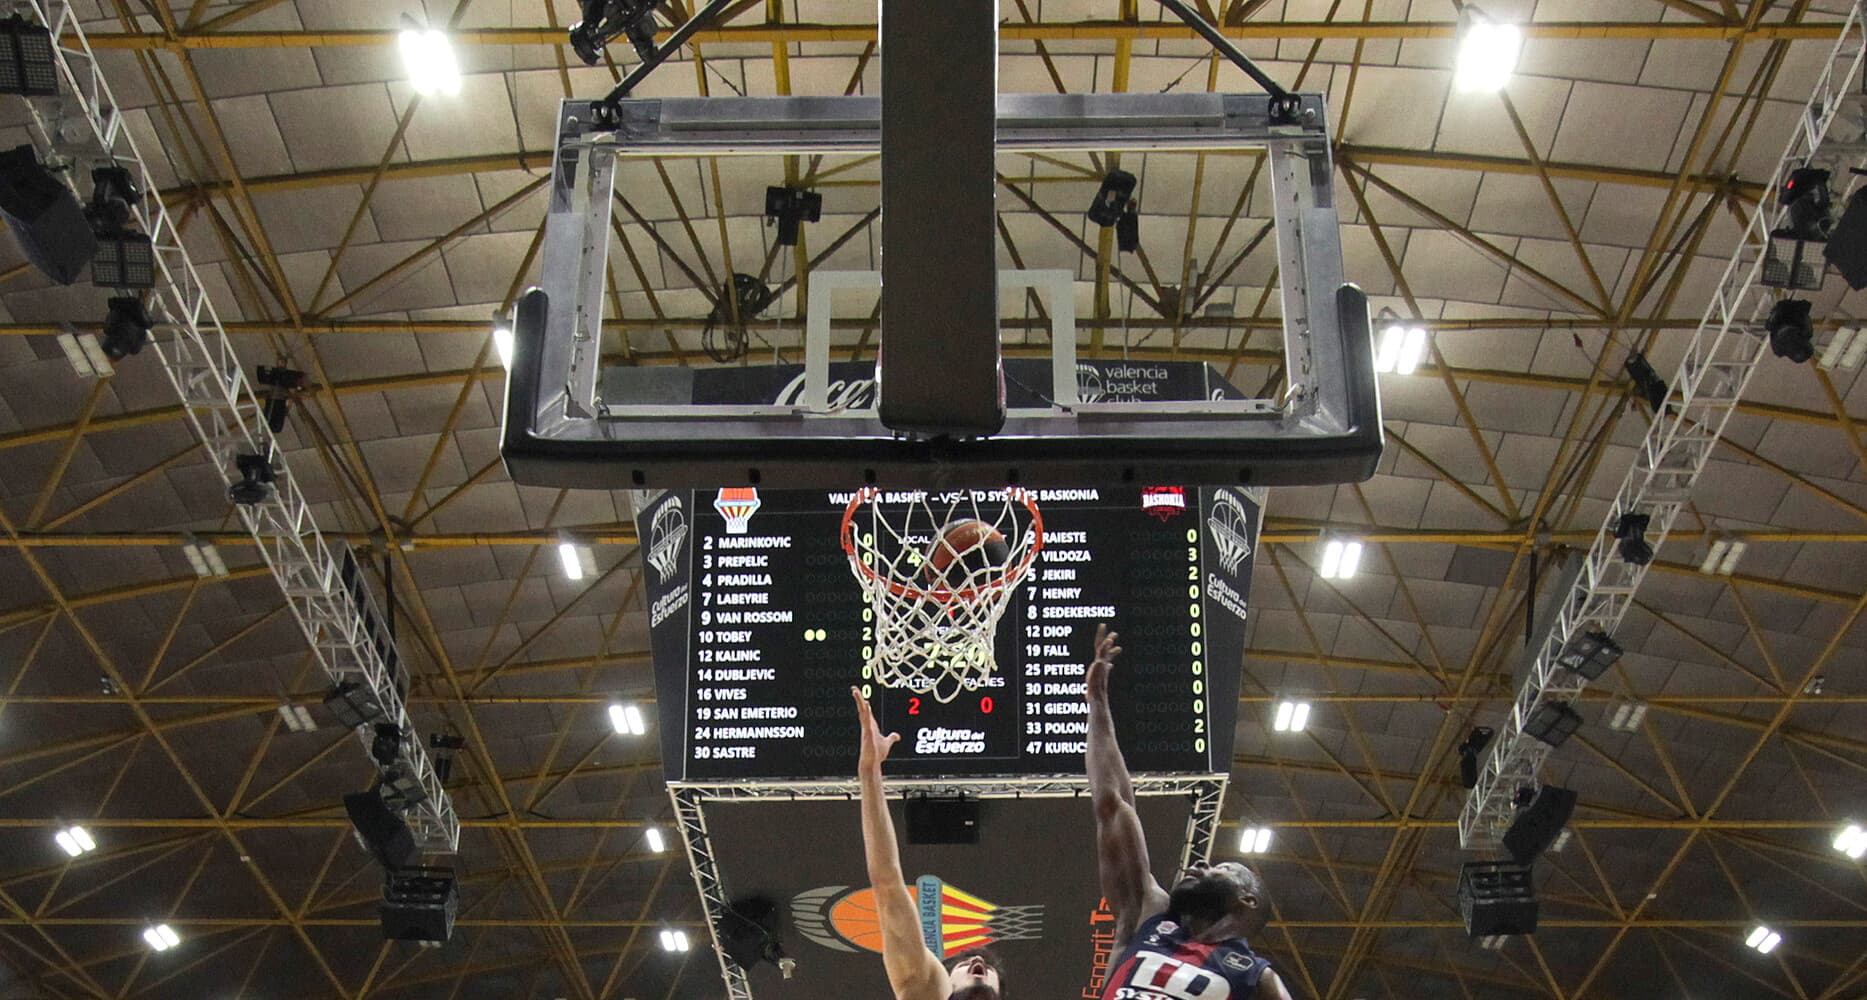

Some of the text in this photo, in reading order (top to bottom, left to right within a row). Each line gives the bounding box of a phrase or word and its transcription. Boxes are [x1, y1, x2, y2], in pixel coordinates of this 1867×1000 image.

[1105, 365, 1168, 379] valencia
[1106, 380, 1158, 394] basket
[886, 491, 928, 504] BASKET
[1040, 488, 1099, 501] BASKONIA
[863, 534, 873, 546] 0
[1027, 531, 1086, 544] 2 RAIESTE
[1187, 529, 1197, 542] 0
[703, 536, 791, 550] 2 MARINKOVIC
[863, 553, 873, 565] 0
[1042, 550, 1091, 562] VILDOZA
[1188, 548, 1198, 561] 3
[703, 555, 768, 568] 3 PREPELIC
[1027, 568, 1076, 581] 5 JEKIRI
[1188, 567, 1198, 580] 2
[702, 574, 772, 587] 4 PRADILLA
[1208, 572, 1240, 602] Cultura
[1028, 588, 1082, 600] 7 HENRY
[1189, 586, 1199, 598] 0
[702, 592, 768, 606] 7 LABEYRIE
[1207, 584, 1247, 620] Esfuerzo
[862, 608, 872, 622] 0
[1027, 606, 1116, 620] 8 SEDEKERSKIS
[1190, 604, 1200, 617] 0
[701, 611, 793, 625] 9 VAN ROSSOM
[862, 627, 872, 640] 2
[1026, 626, 1072, 638] 12 DIOP
[1190, 623, 1200, 636] 0
[699, 631, 752, 643] 10 TOBEY
[862, 646, 872, 660] 0
[1026, 645, 1070, 656] 19 FALL
[1192, 642, 1201, 656] 0
[698, 650, 760, 662] 12 KALINIC
[862, 665, 872, 679] 0
[1025, 664, 1085, 676] 25 PETERS
[1192, 661, 1202, 675] 0
[698, 669, 776, 681] 14 DUBLJEVIC
[862, 684, 872, 698] 0
[1026, 683, 1088, 695] 30 DRAGIC
[1193, 680, 1202, 694] 0
[697, 688, 746, 700] 16 VIVES
[908, 698, 921, 714] 2
[980, 696, 994, 714] 0
[1026, 703, 1040, 714] 31
[1194, 700, 1204, 714] 0
[696, 708, 798, 720] 19 SAN EMETERIO
[695, 727, 804, 740] 24 HERMANNSSON
[1026, 722, 1041, 734] 33
[1194, 720, 1204, 734] 2
[917, 727, 971, 741] Cultura
[915, 739, 986, 754] Esfuerzo
[1026, 742, 1042, 754] 47
[1195, 738, 1205, 752] 0
[694, 747, 756, 758] 30 SASTRE
[923, 880, 939, 918] BASKET
